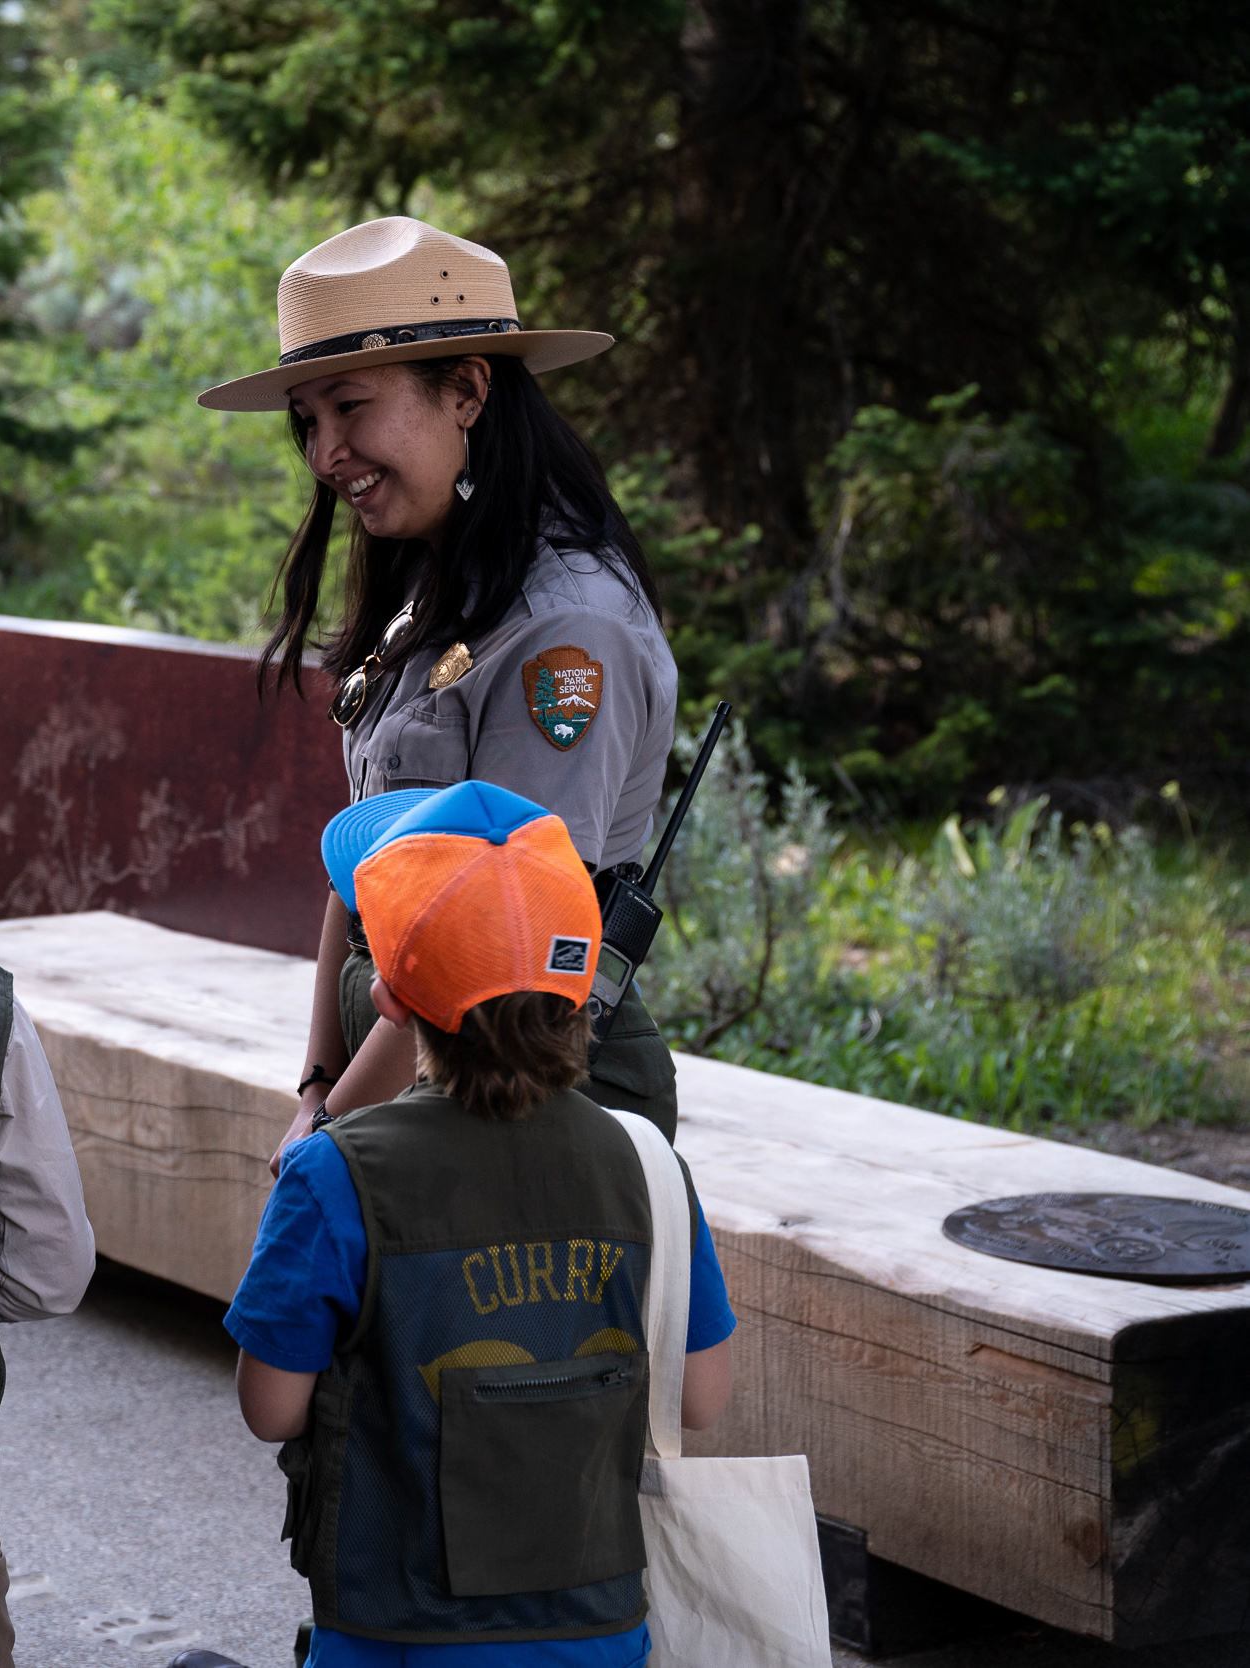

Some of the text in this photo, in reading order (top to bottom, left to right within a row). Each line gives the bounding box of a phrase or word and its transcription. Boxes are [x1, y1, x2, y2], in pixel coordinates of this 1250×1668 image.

[554, 668, 598, 678] NATIONAL
[564, 677, 587, 685] PARK
[559, 683, 593, 694] SERVICE
[634, 895, 656, 915] MOTOROLA
[461, 1238, 624, 1315] CURRY
